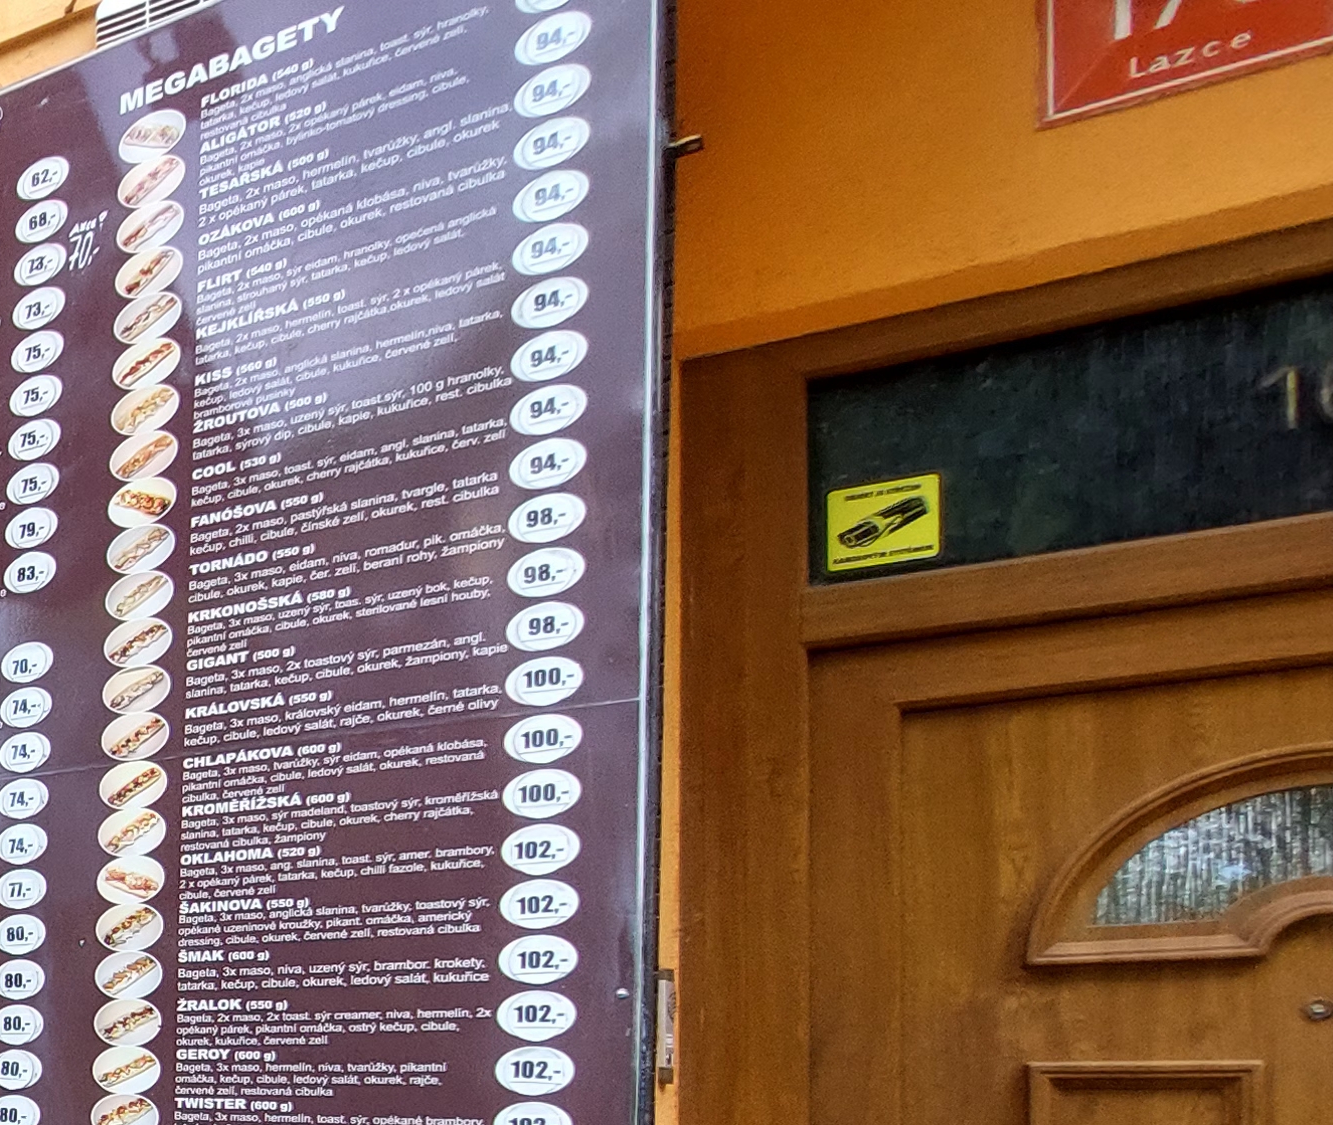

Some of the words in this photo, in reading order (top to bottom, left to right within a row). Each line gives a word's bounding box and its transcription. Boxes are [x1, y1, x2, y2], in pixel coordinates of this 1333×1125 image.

[119, 5, 346, 115] MEGABAGETY
[1128, 30, 1251, 78] Lazce
[201, 75, 269, 108] FLORIDA
[201, 114, 282, 153] ALIGÁTOR
[31, 168, 58, 188] 62,-
[199, 157, 284, 199] TESAŘSKÁ
[29, 211, 56, 231] 68,-
[198, 210, 275, 245] OZÁKOVA
[197, 269, 243, 294] FLIRT
[196, 297, 299, 340] KEJKLÍŘSKÁ
[530, 346, 570, 368] 94,-
[194, 364, 232, 386] KISS
[193, 401, 281, 434] ŽROUTOVA
[192, 460, 236, 481] COOL
[526, 507, 567, 528] 98,-
[19, 521, 45, 539] 79,-
[189, 547, 269, 577] TORNÁDO
[17, 565, 44, 582] 83,-
[188, 589, 304, 624] KRKONOŠSKÁ
[186, 651, 249, 671] GIGANT
[523, 668, 575, 689] 100,-
[184, 692, 285, 720] KRÁLOVSKÁ
[183, 741, 294, 770] CHLAPÁKOVA
[181, 790, 302, 817] KROMĚŘÍŽSKÁ
[180, 846, 272, 866] OKLAHOMA
[179, 894, 262, 915] ŠAKINOVA
[6, 927, 33, 944] 80,-
[177, 947, 224, 964] ŠMAK
[517, 950, 569, 970] 102,-
[177, 998, 242, 1011] ŽRALOK
[176, 1049, 230, 1061] GEROY
[174, 1097, 247, 1111] TWISTER
